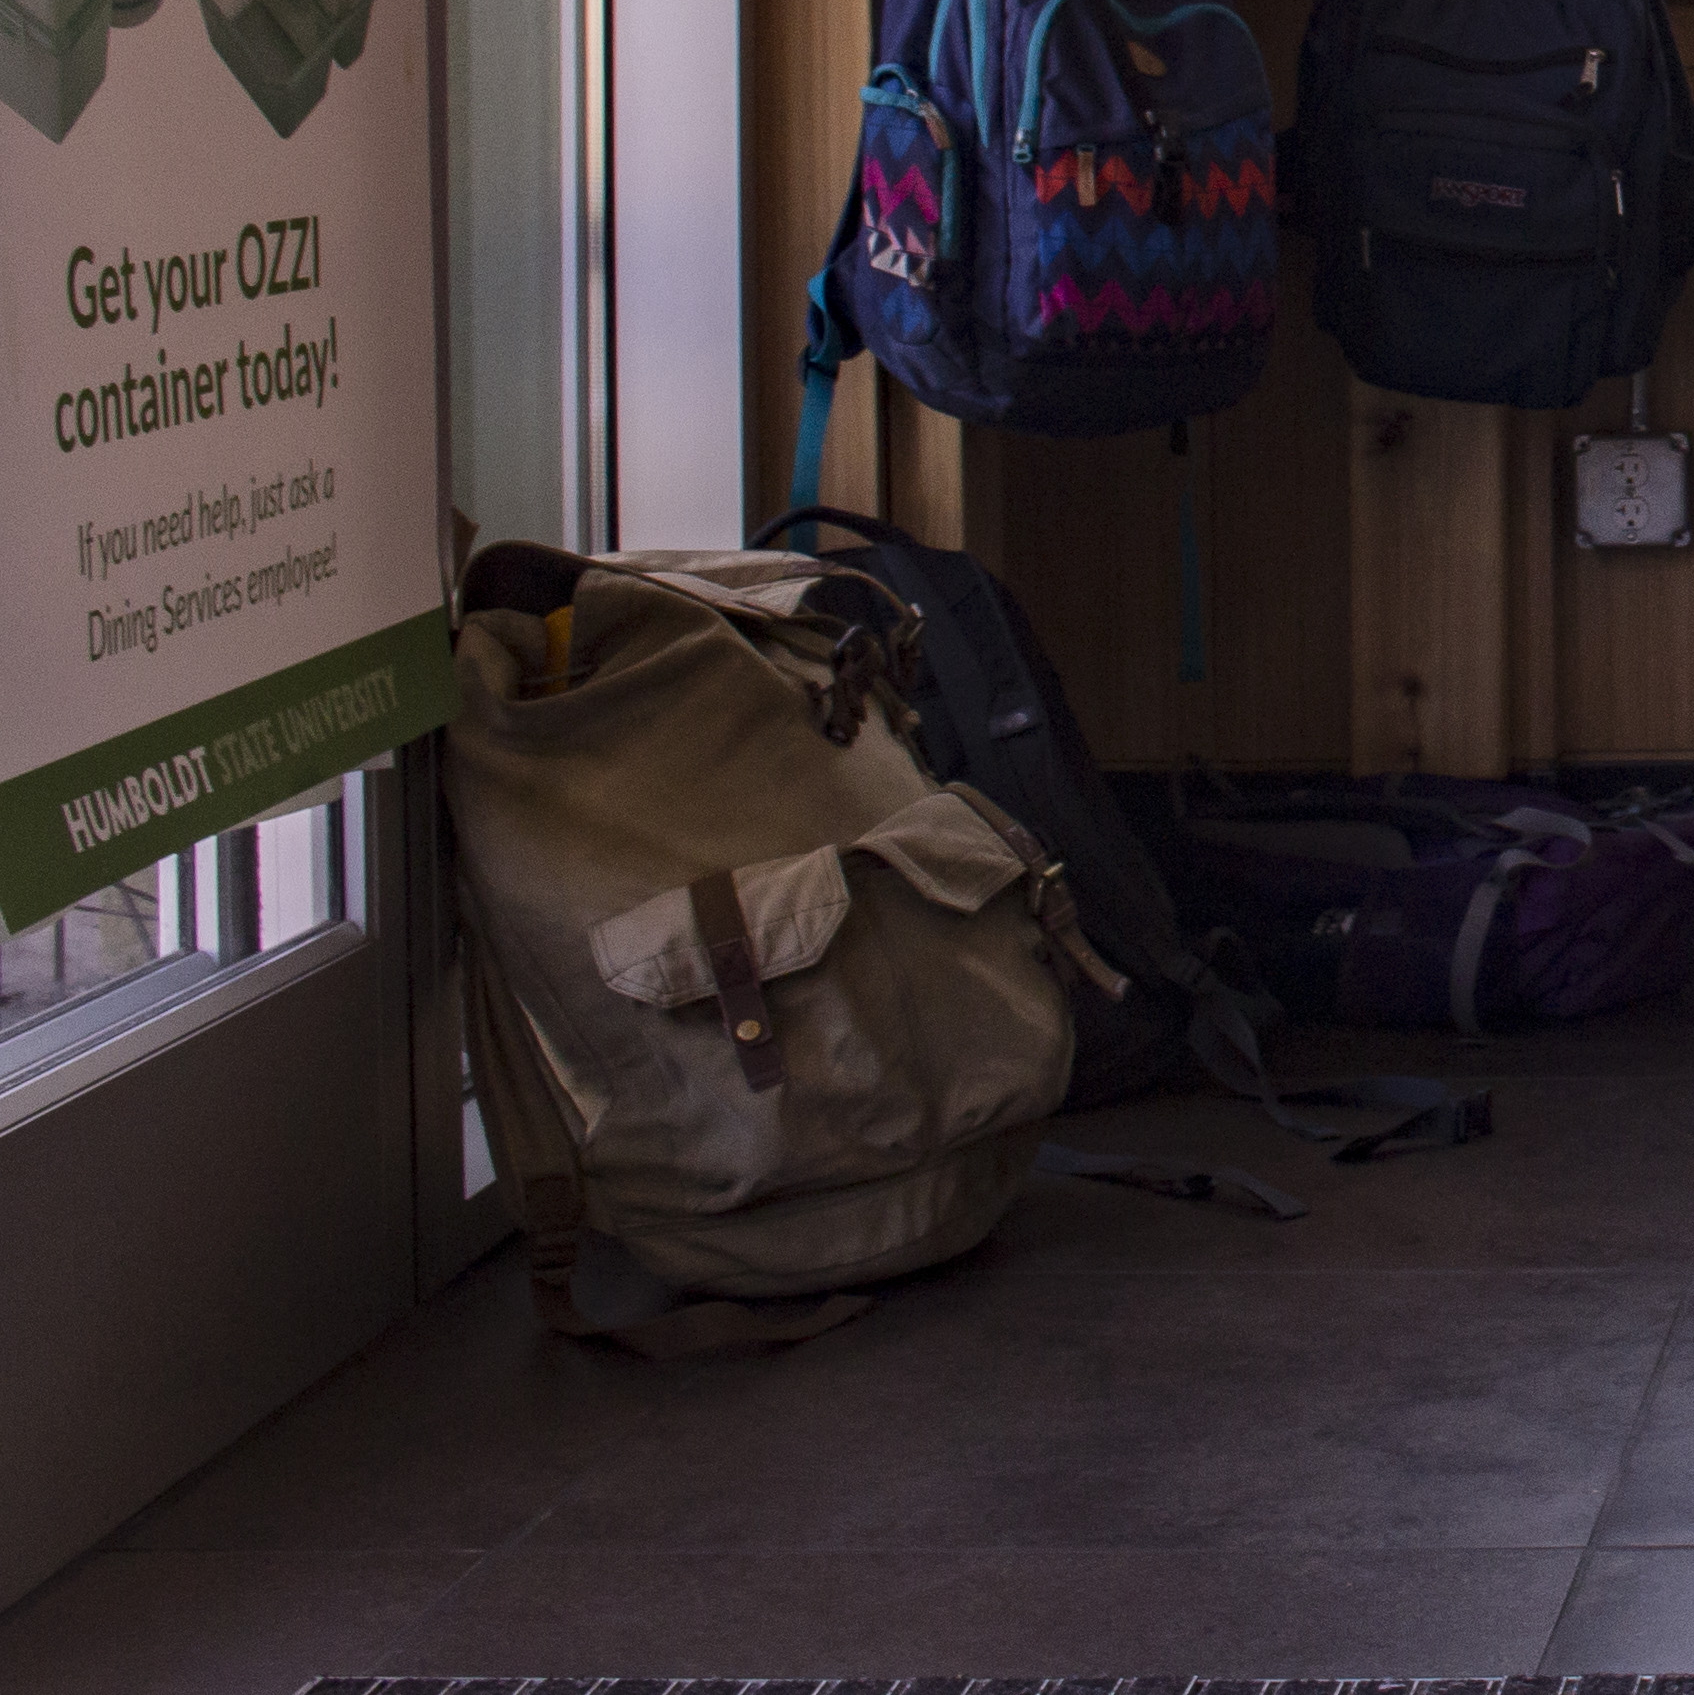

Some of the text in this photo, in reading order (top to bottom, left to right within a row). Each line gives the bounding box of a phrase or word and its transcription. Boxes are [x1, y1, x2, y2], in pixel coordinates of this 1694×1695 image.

[65, 215, 320, 335] Get your OZZI
[54, 316, 338, 453] container today!
[77, 458, 335, 581] If you need help, just ask a
[87, 530, 338, 662] Dining Services employee!
[60, 665, 400, 854] HUMBOLDT STATE UNIVERSITY
